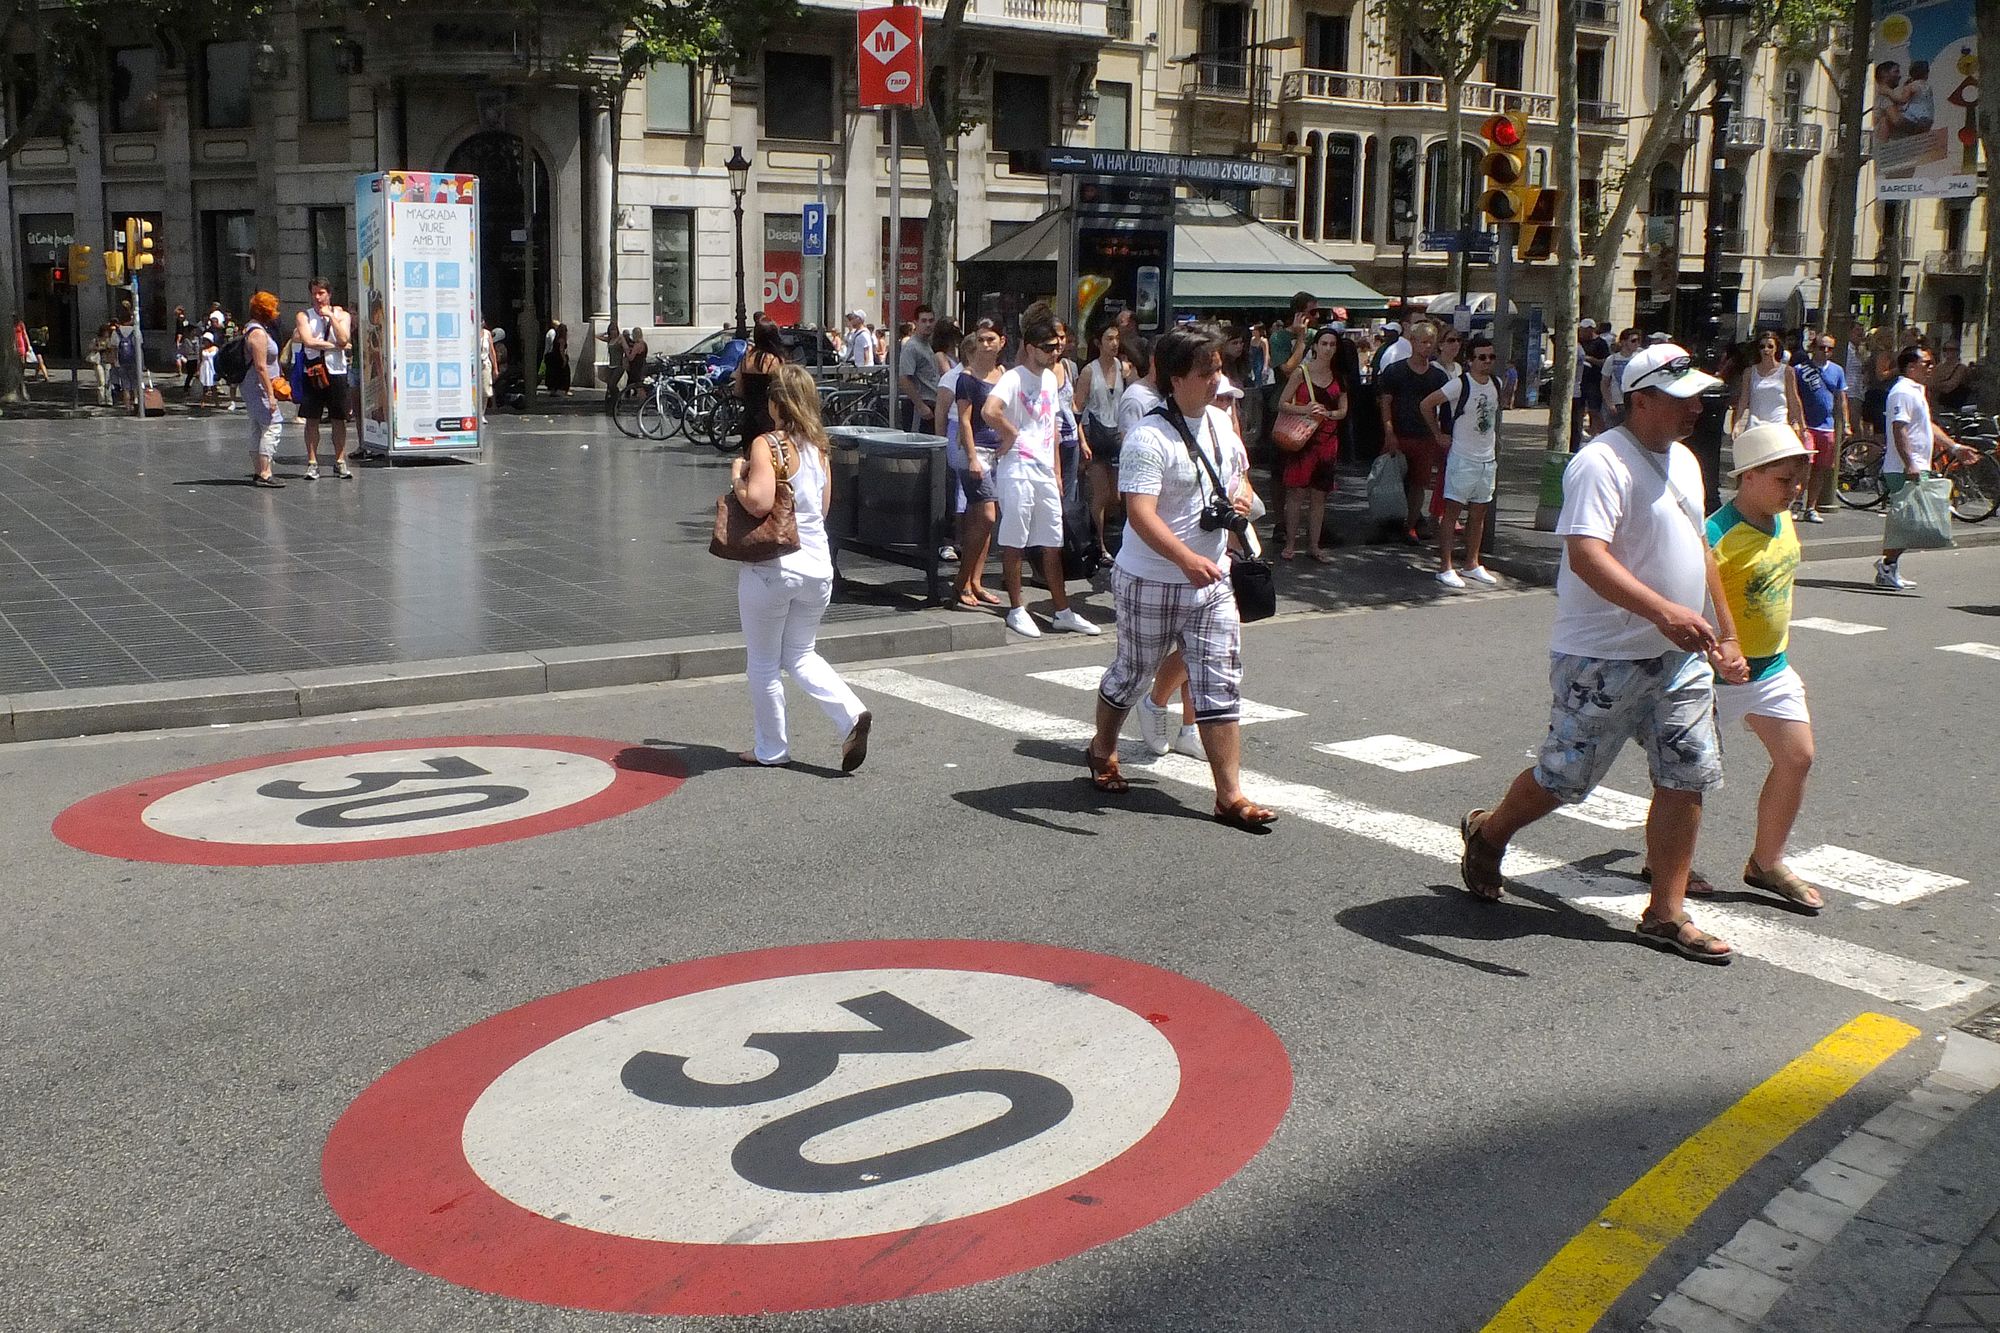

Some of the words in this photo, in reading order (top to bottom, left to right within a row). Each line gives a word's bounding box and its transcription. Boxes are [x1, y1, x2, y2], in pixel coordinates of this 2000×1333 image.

[875, 31, 895, 52] M
[1091, 153, 1105, 169] YA
[1106, 155, 1129, 171] HAY
[1168, 159, 1181, 175] DE
[1181, 159, 1220, 178] NAVIDAD
[1221, 163, 1233, 178] ¿Y
[406, 208, 457, 221] M'AGRADA
[808, 210, 819, 231] P
[418, 222, 446, 234] VIURE
[412, 234, 434, 246] AMB
[764, 271, 800, 304] 50
[258, 755, 529, 828] 30
[620, 990, 1074, 1193] 30
